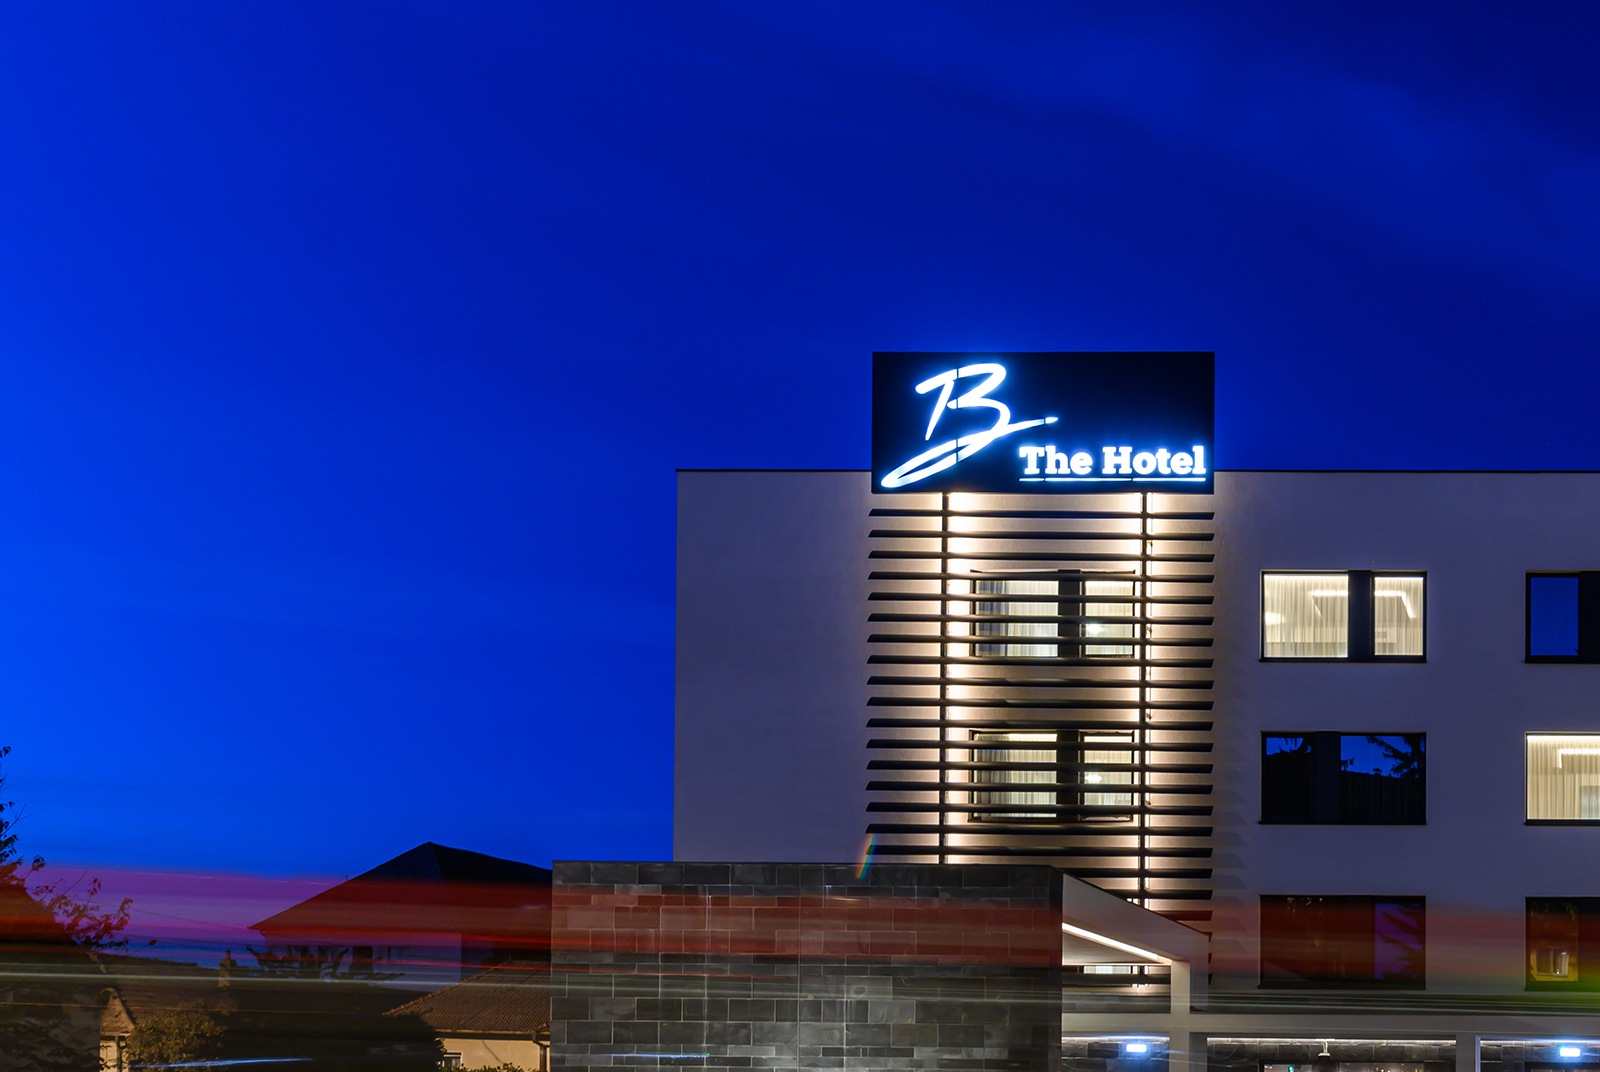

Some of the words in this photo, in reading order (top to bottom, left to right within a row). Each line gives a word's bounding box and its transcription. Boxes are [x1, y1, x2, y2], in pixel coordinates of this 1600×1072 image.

[881, 362, 1058, 488] B
[1019, 446, 1093, 475] The
[1102, 445, 1207, 475] Hotel
